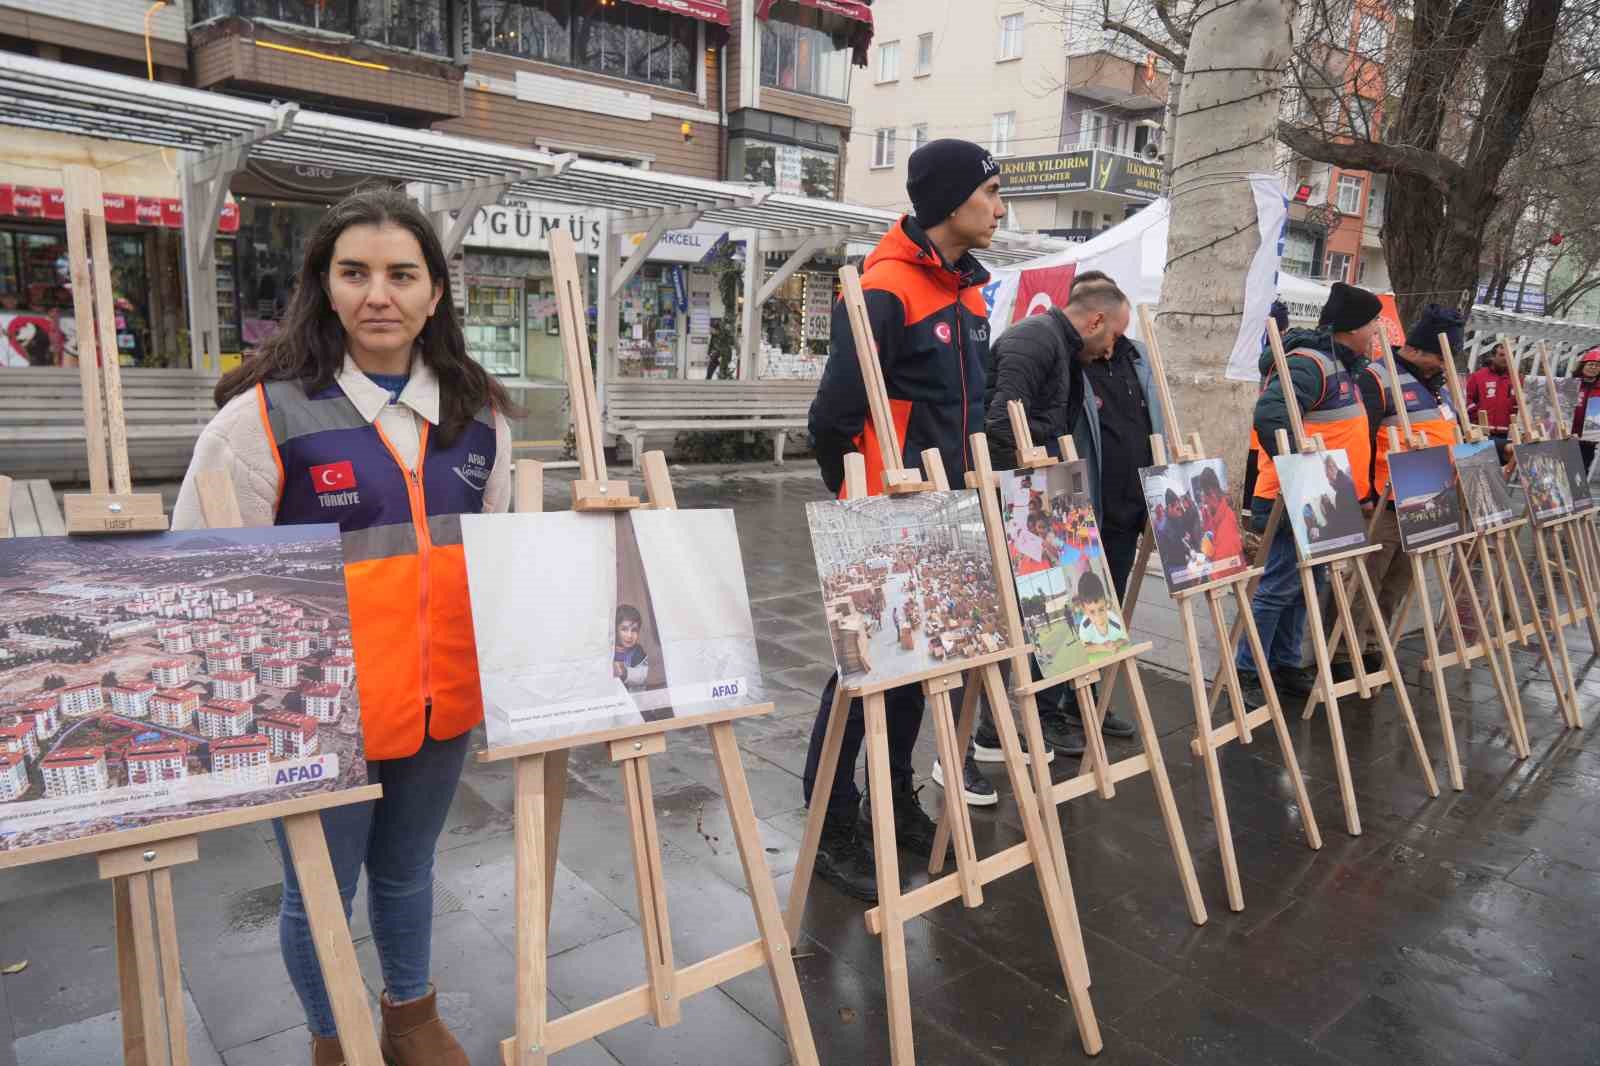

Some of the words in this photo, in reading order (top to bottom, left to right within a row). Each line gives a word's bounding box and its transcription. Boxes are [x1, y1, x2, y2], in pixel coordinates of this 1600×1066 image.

[1001, 162, 1035, 175] LKNUR
[1039, 157, 1089, 171] YILDIRIM
[1039, 172, 1072, 183] CENTER
[468, 453, 486, 466] AFAD
[318, 492, 361, 507] TÜRKİYE
[712, 683, 739, 699] AFAD
[275, 761, 324, 785] AFAD
